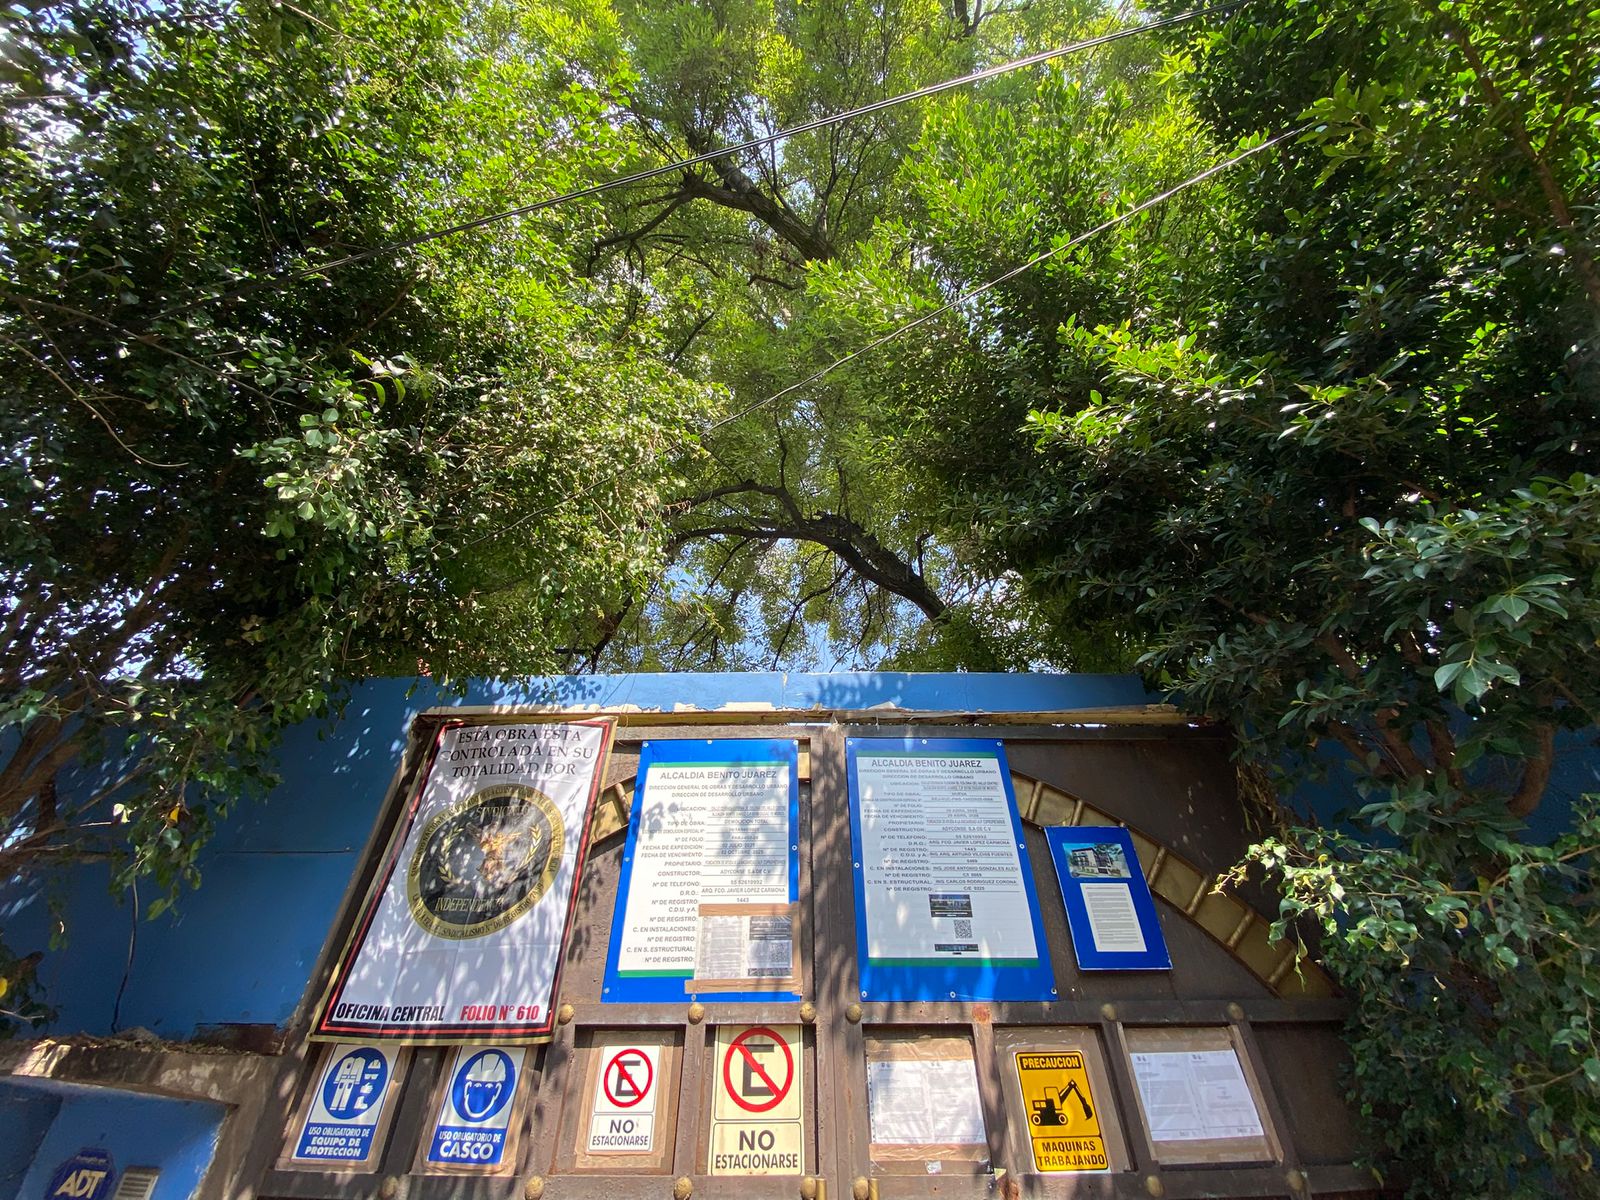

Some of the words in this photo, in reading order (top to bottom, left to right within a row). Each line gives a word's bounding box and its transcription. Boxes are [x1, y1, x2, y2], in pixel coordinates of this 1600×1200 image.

[458, 729, 491, 743] ESTA
[495, 728, 538, 741] OBRA
[543, 729, 582, 741] ESTA
[547, 747, 568, 758] EN
[573, 747, 594, 759] SU
[452, 763, 540, 777] TOTALIDAD
[544, 763, 576, 775] POR
[871, 759, 914, 768] ALCALDIA
[915, 759, 946, 768] BENITO
[948, 759, 982, 768] JUAREZ
[660, 771, 705, 780] ALCALDIA
[707, 770, 740, 779] BENITO
[741, 770, 777, 779] JUAREZ
[336, 1003, 390, 1021] OFICINA
[391, 1006, 445, 1022] CENTRAL
[460, 1005, 496, 1021] FOLIO
[516, 1005, 540, 1020] 610
[1022, 1057, 1080, 1069] PRECAUCION
[308, 1126, 321, 1136] USO
[322, 1127, 362, 1137] OBLIGATORIO
[362, 1128, 371, 1137] DE
[609, 1119, 635, 1134] NO
[311, 1136, 347, 1147] EQUIPO
[348, 1138, 361, 1147] DE
[439, 1131, 451, 1141] USO
[452, 1131, 492, 1141] OBLIGATORIO
[493, 1133, 502, 1142] DE
[592, 1135, 648, 1146] ESTACIONARSE
[739, 1129, 775, 1151] NO
[304, 1146, 362, 1157] PROTECCION
[439, 1141, 494, 1160] CASCO
[1041, 1140, 1096, 1153] MAQUINAS
[715, 1153, 798, 1169] ESTACIONARSE
[1037, 1153, 1105, 1167] TRABAJANDO
[53, 1169, 107, 1199] ADT
